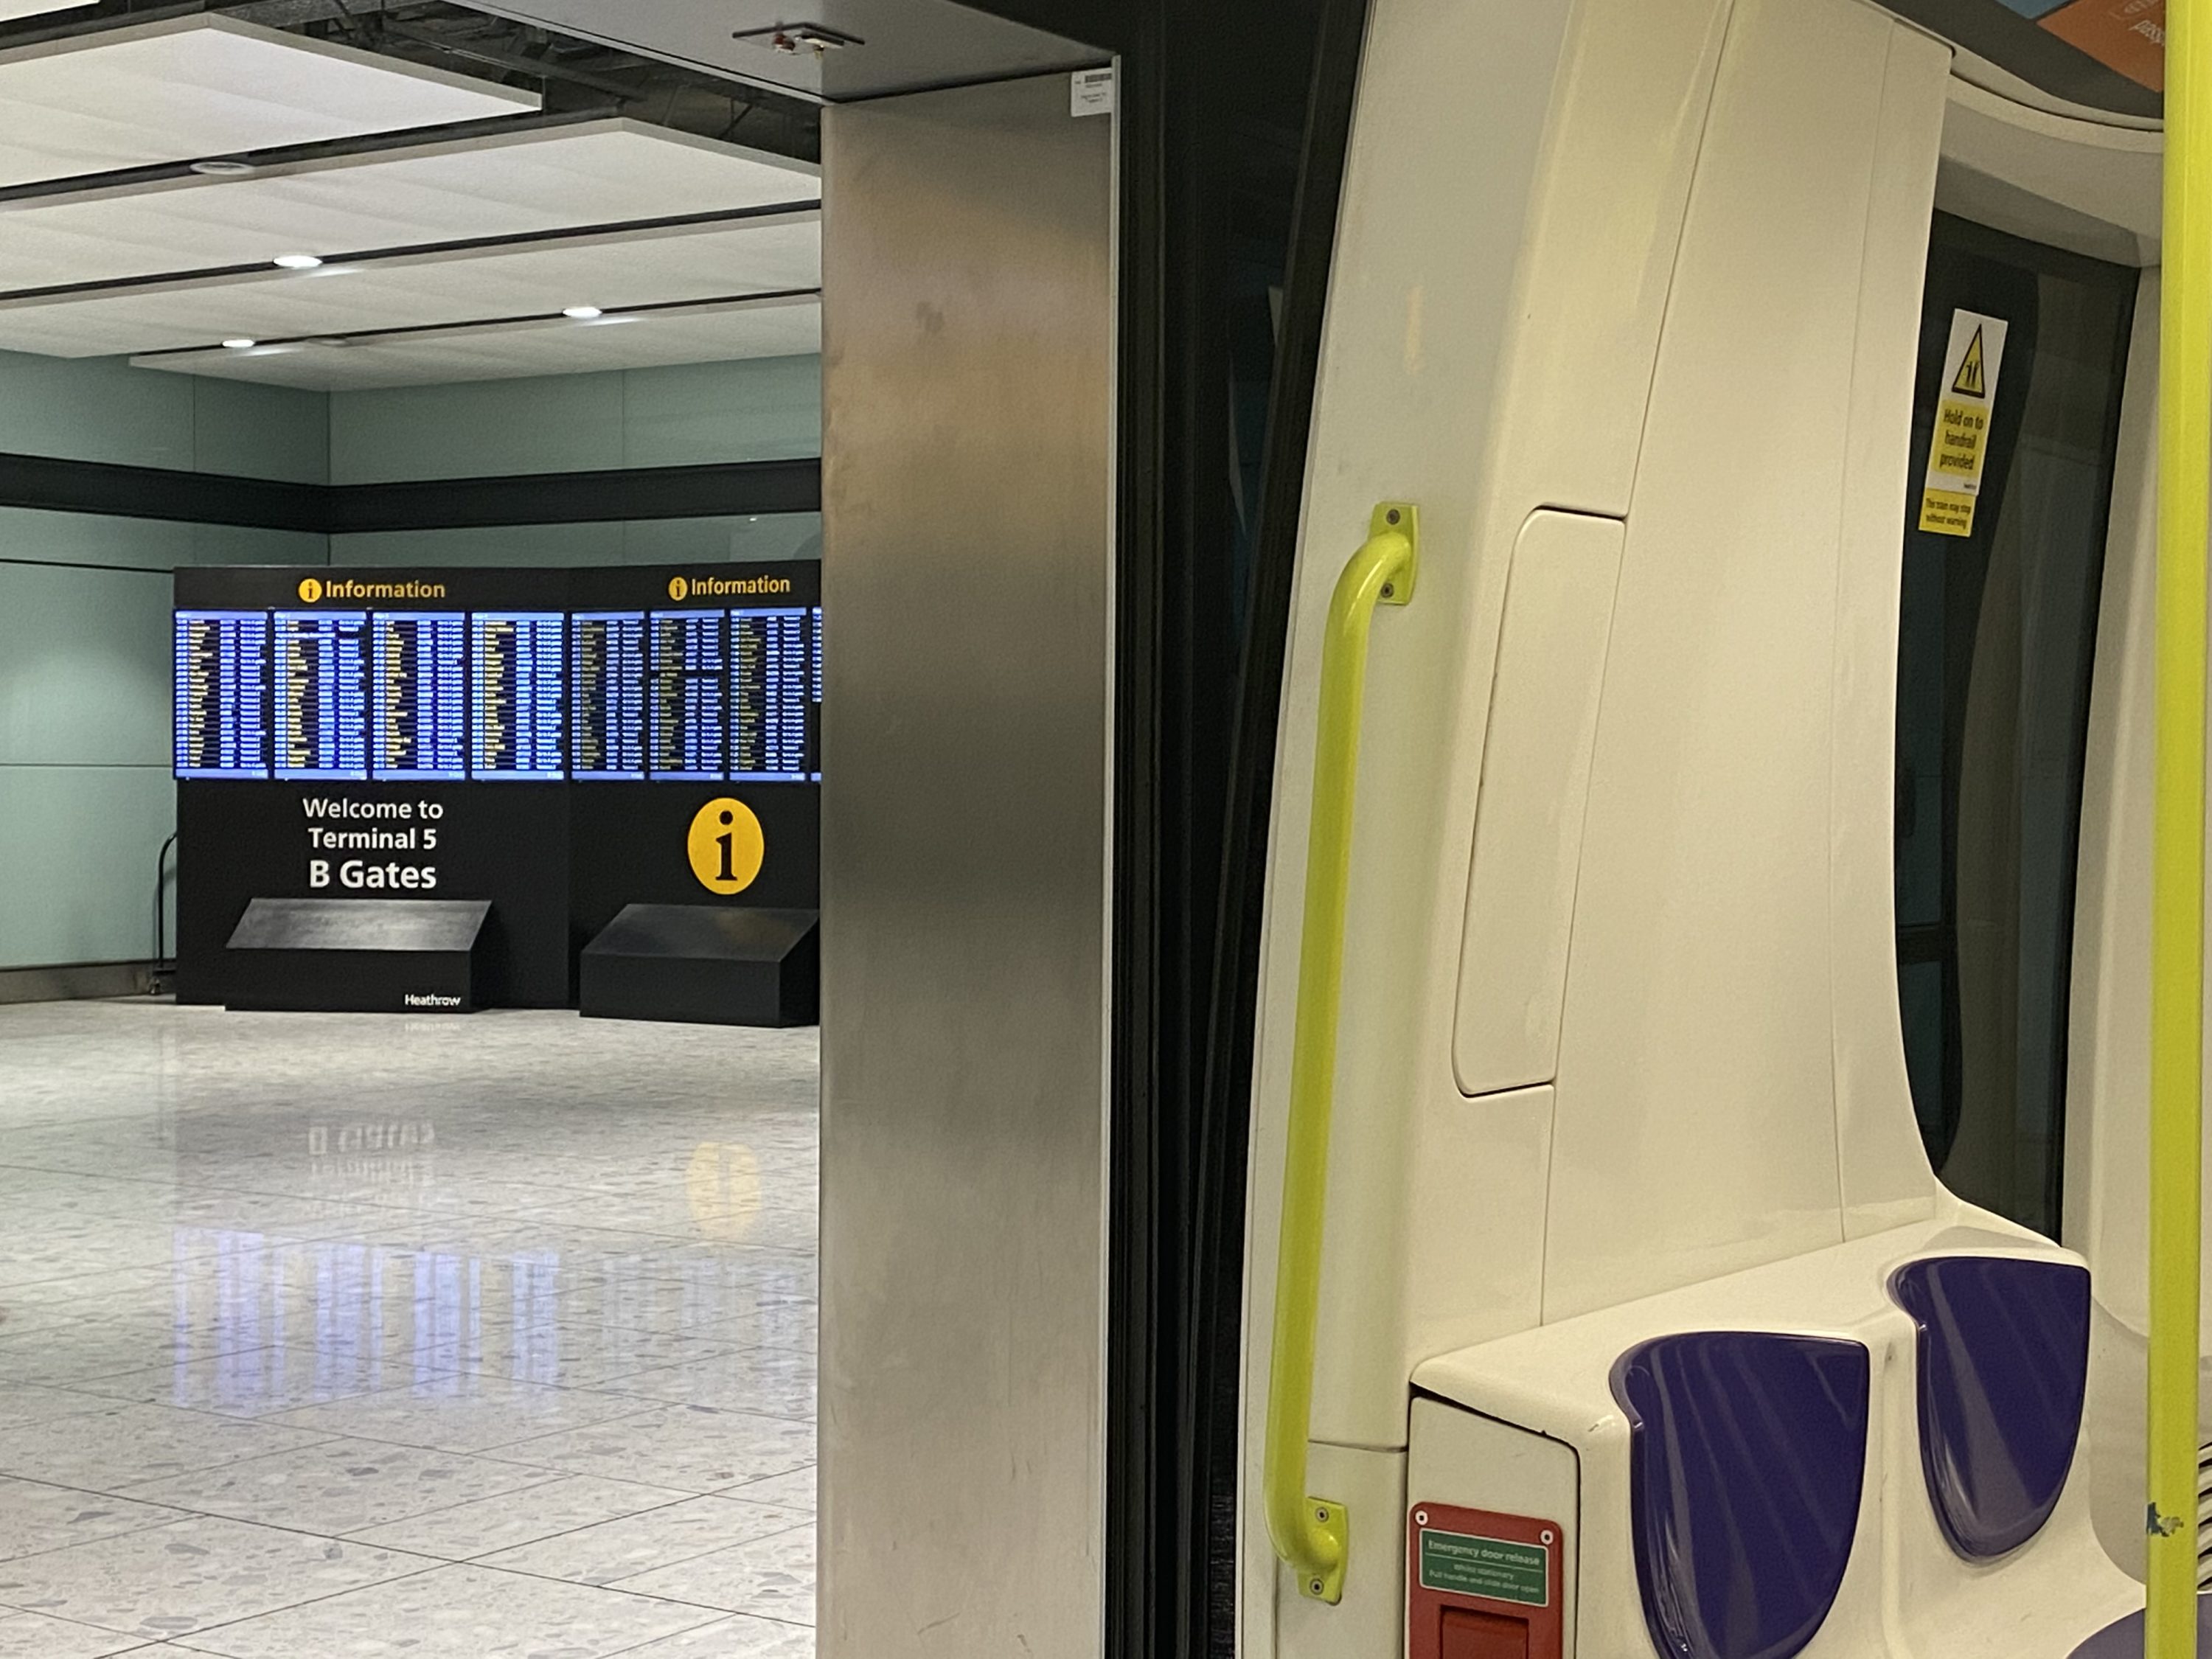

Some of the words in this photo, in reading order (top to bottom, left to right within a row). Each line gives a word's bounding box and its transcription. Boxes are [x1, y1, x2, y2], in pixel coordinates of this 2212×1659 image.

[1944, 408, 1963, 426] Hold
[1963, 416, 1974, 428] on
[1975, 416, 1984, 430] to
[1944, 429, 1977, 450] handrail
[1939, 453, 1975, 470] provided
[326, 580, 445, 598] Information
[692, 575, 790, 596] Information
[302, 797, 412, 818] Welcome
[417, 799, 444, 819] to
[307, 827, 415, 849] Terminal
[423, 828, 437, 849] 5
[310, 860, 330, 888] B
[340, 860, 437, 888] Gates
[404, 993, 461, 1006] Heathrow
[1428, 1539, 1479, 1558] Emergency
[1481, 1549, 1504, 1559] door
[1506, 1553, 1540, 1565] release
